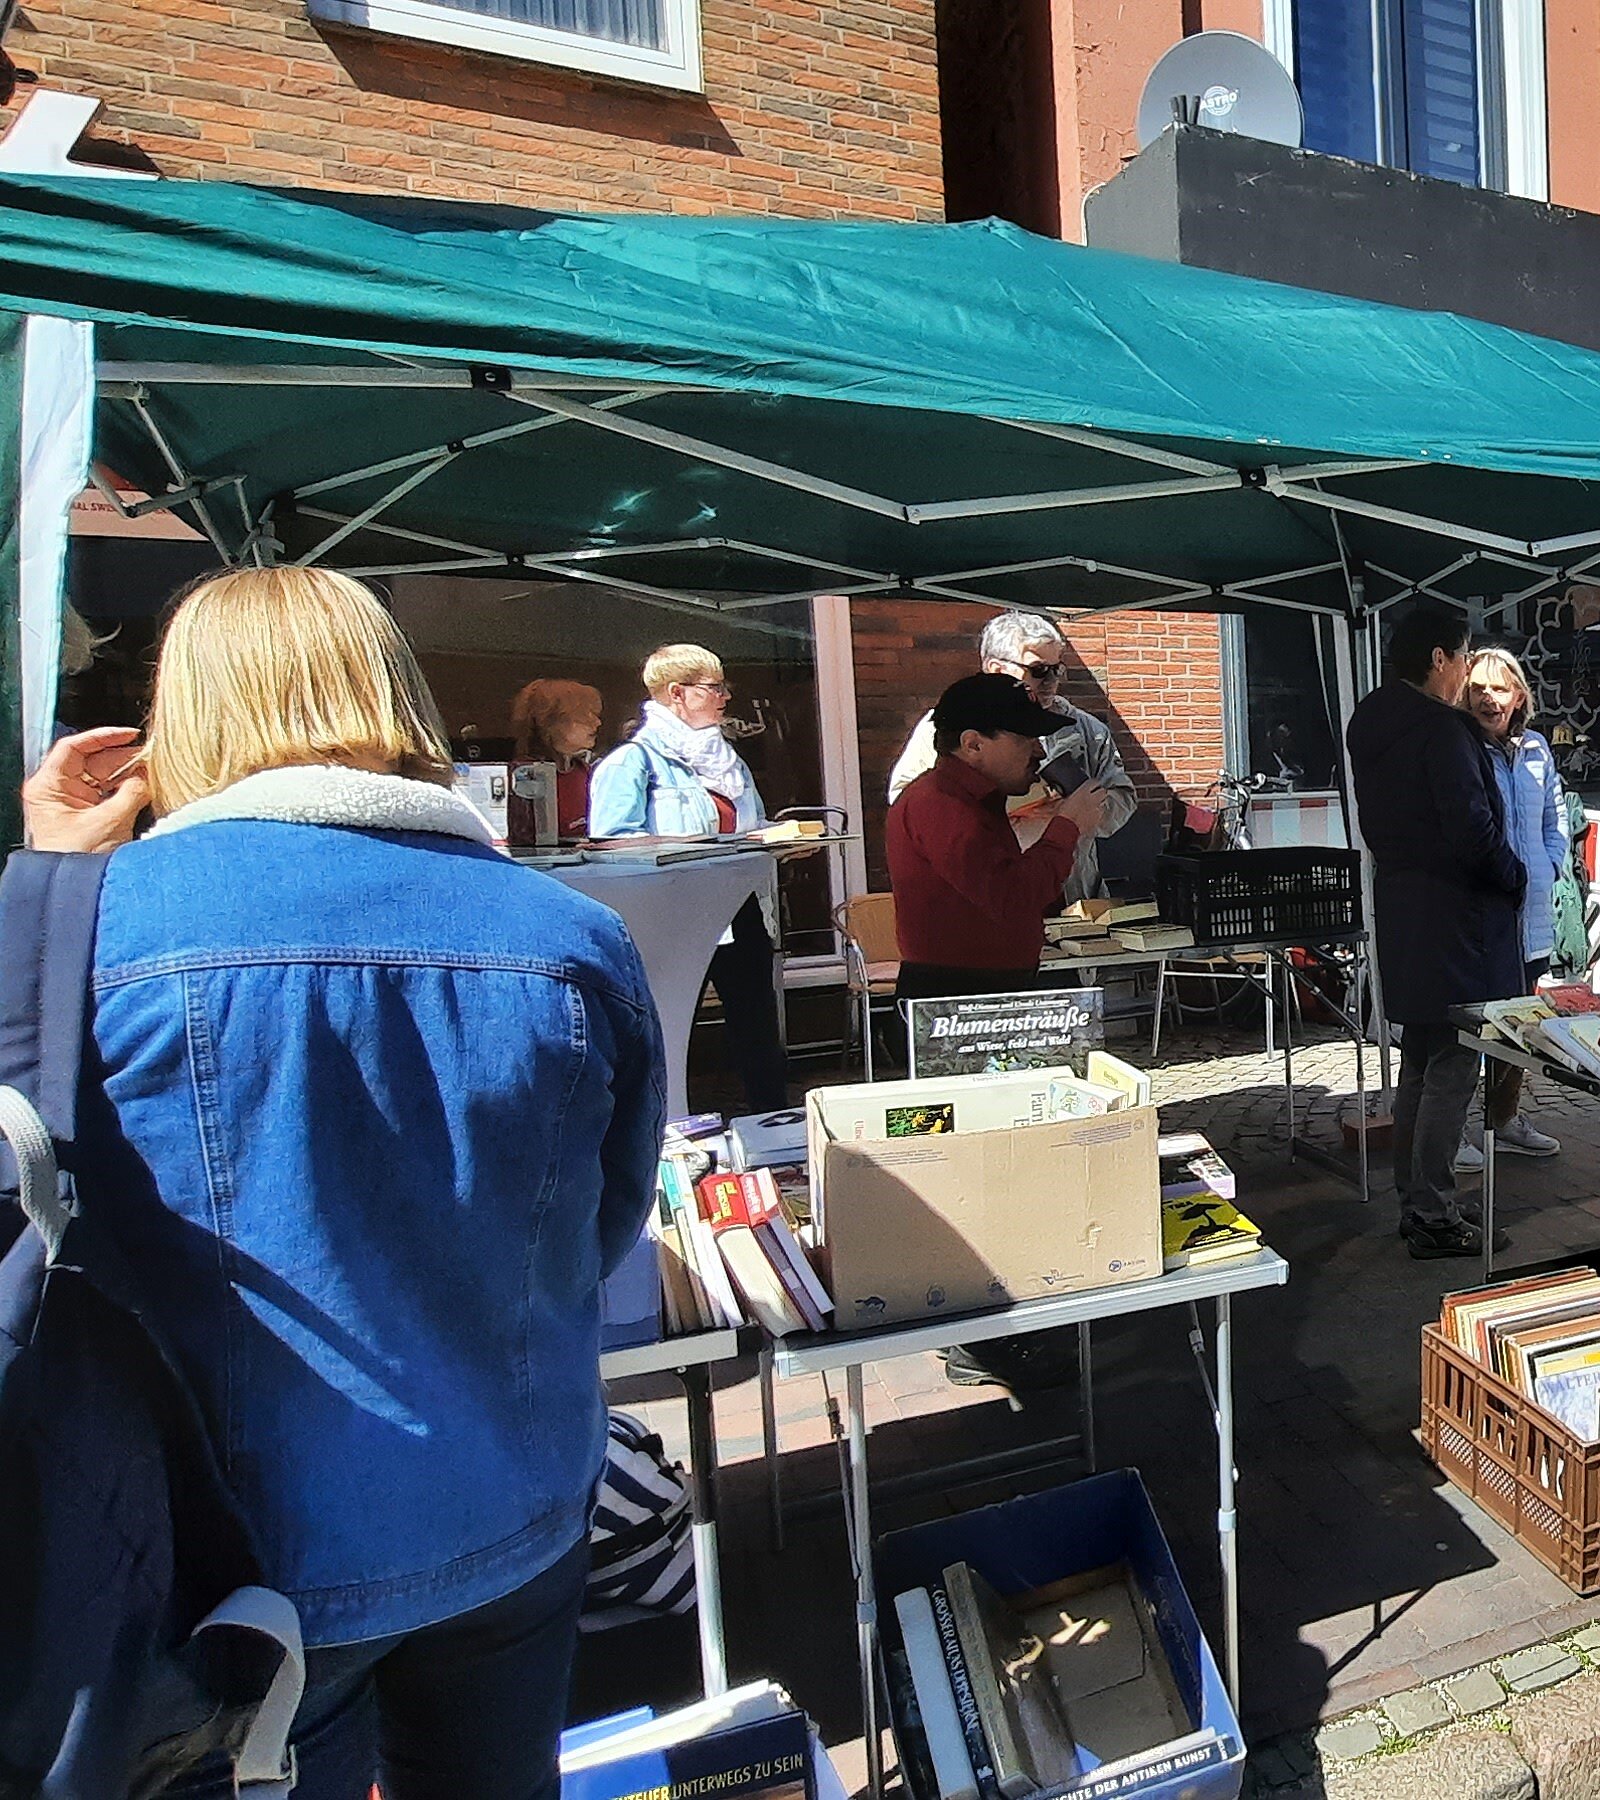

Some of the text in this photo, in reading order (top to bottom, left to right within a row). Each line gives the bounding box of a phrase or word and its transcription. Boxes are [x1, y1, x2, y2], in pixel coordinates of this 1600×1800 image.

[930, 1005, 1091, 1039] Blumensträuße
[1007, 1037, 1028, 1050] Feld
[932, 1589, 955, 1640] GROSSER
[671, 1766, 751, 1800] UNTERWEGS
[754, 1761, 772, 1781] ZU
[773, 1752, 804, 1775] SEIN
[1094, 1781, 1119, 1796] DER
[1121, 1763, 1172, 1788] ANTIKEN
[1173, 1747, 1212, 1769] KUNST
